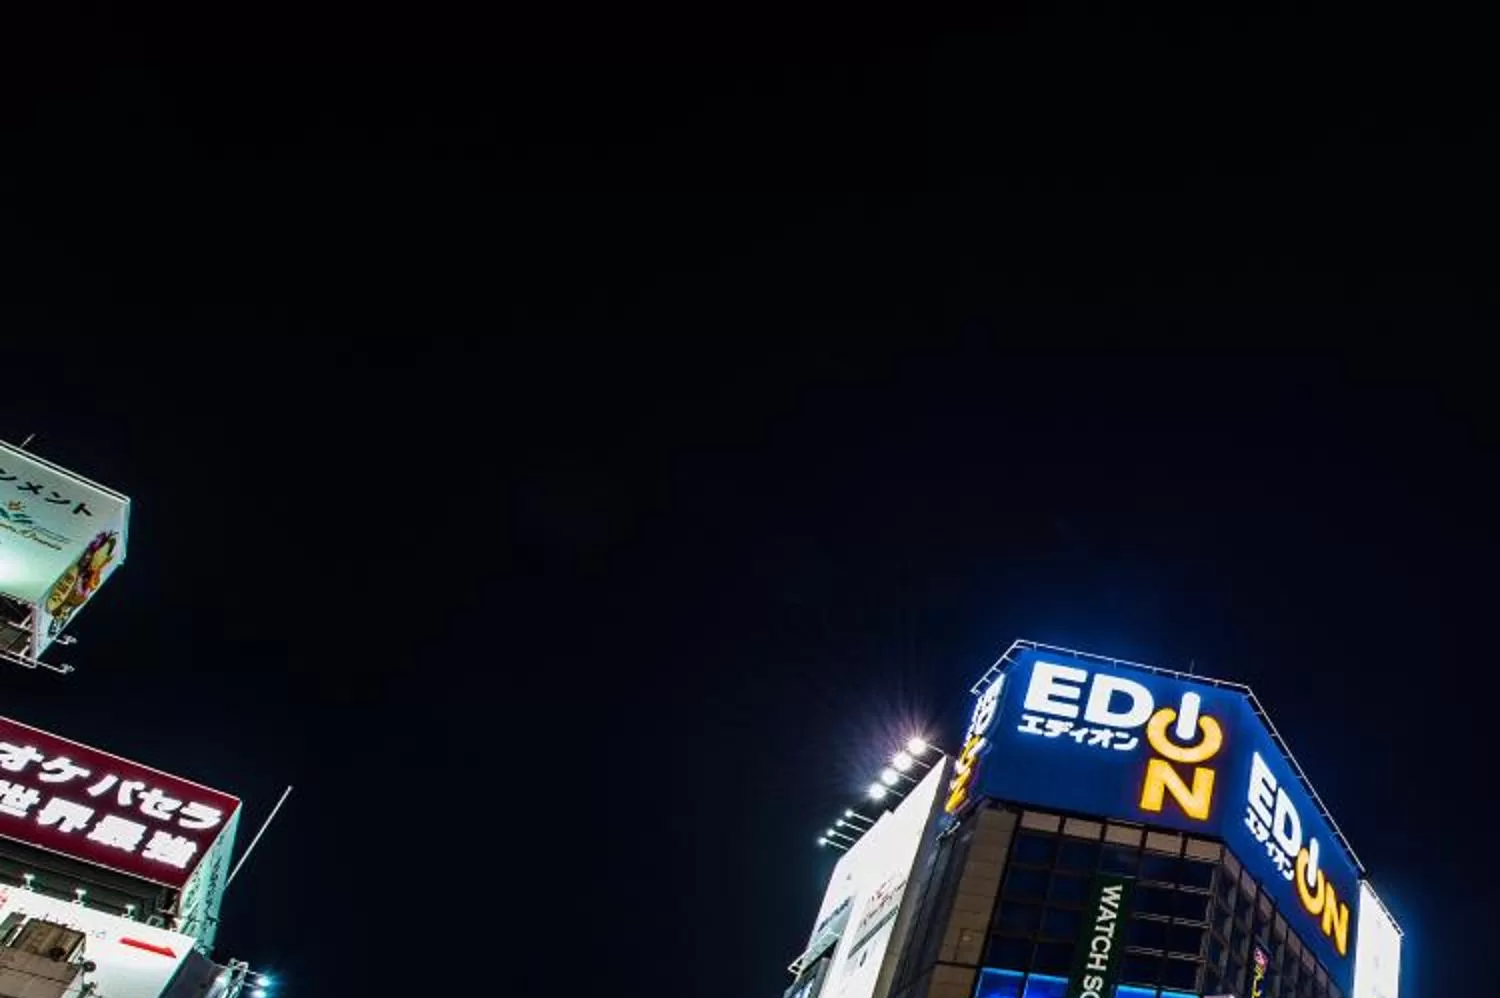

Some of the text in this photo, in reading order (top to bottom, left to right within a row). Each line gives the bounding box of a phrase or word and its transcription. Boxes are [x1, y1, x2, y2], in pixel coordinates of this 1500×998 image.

[1017, 713, 1139, 752] エディオン
[1023, 660, 1224, 822] EDION
[1245, 806, 1295, 882] エディオン
[1247, 751, 1351, 957] EDION
[1091, 884, 1123, 971] WATCH
